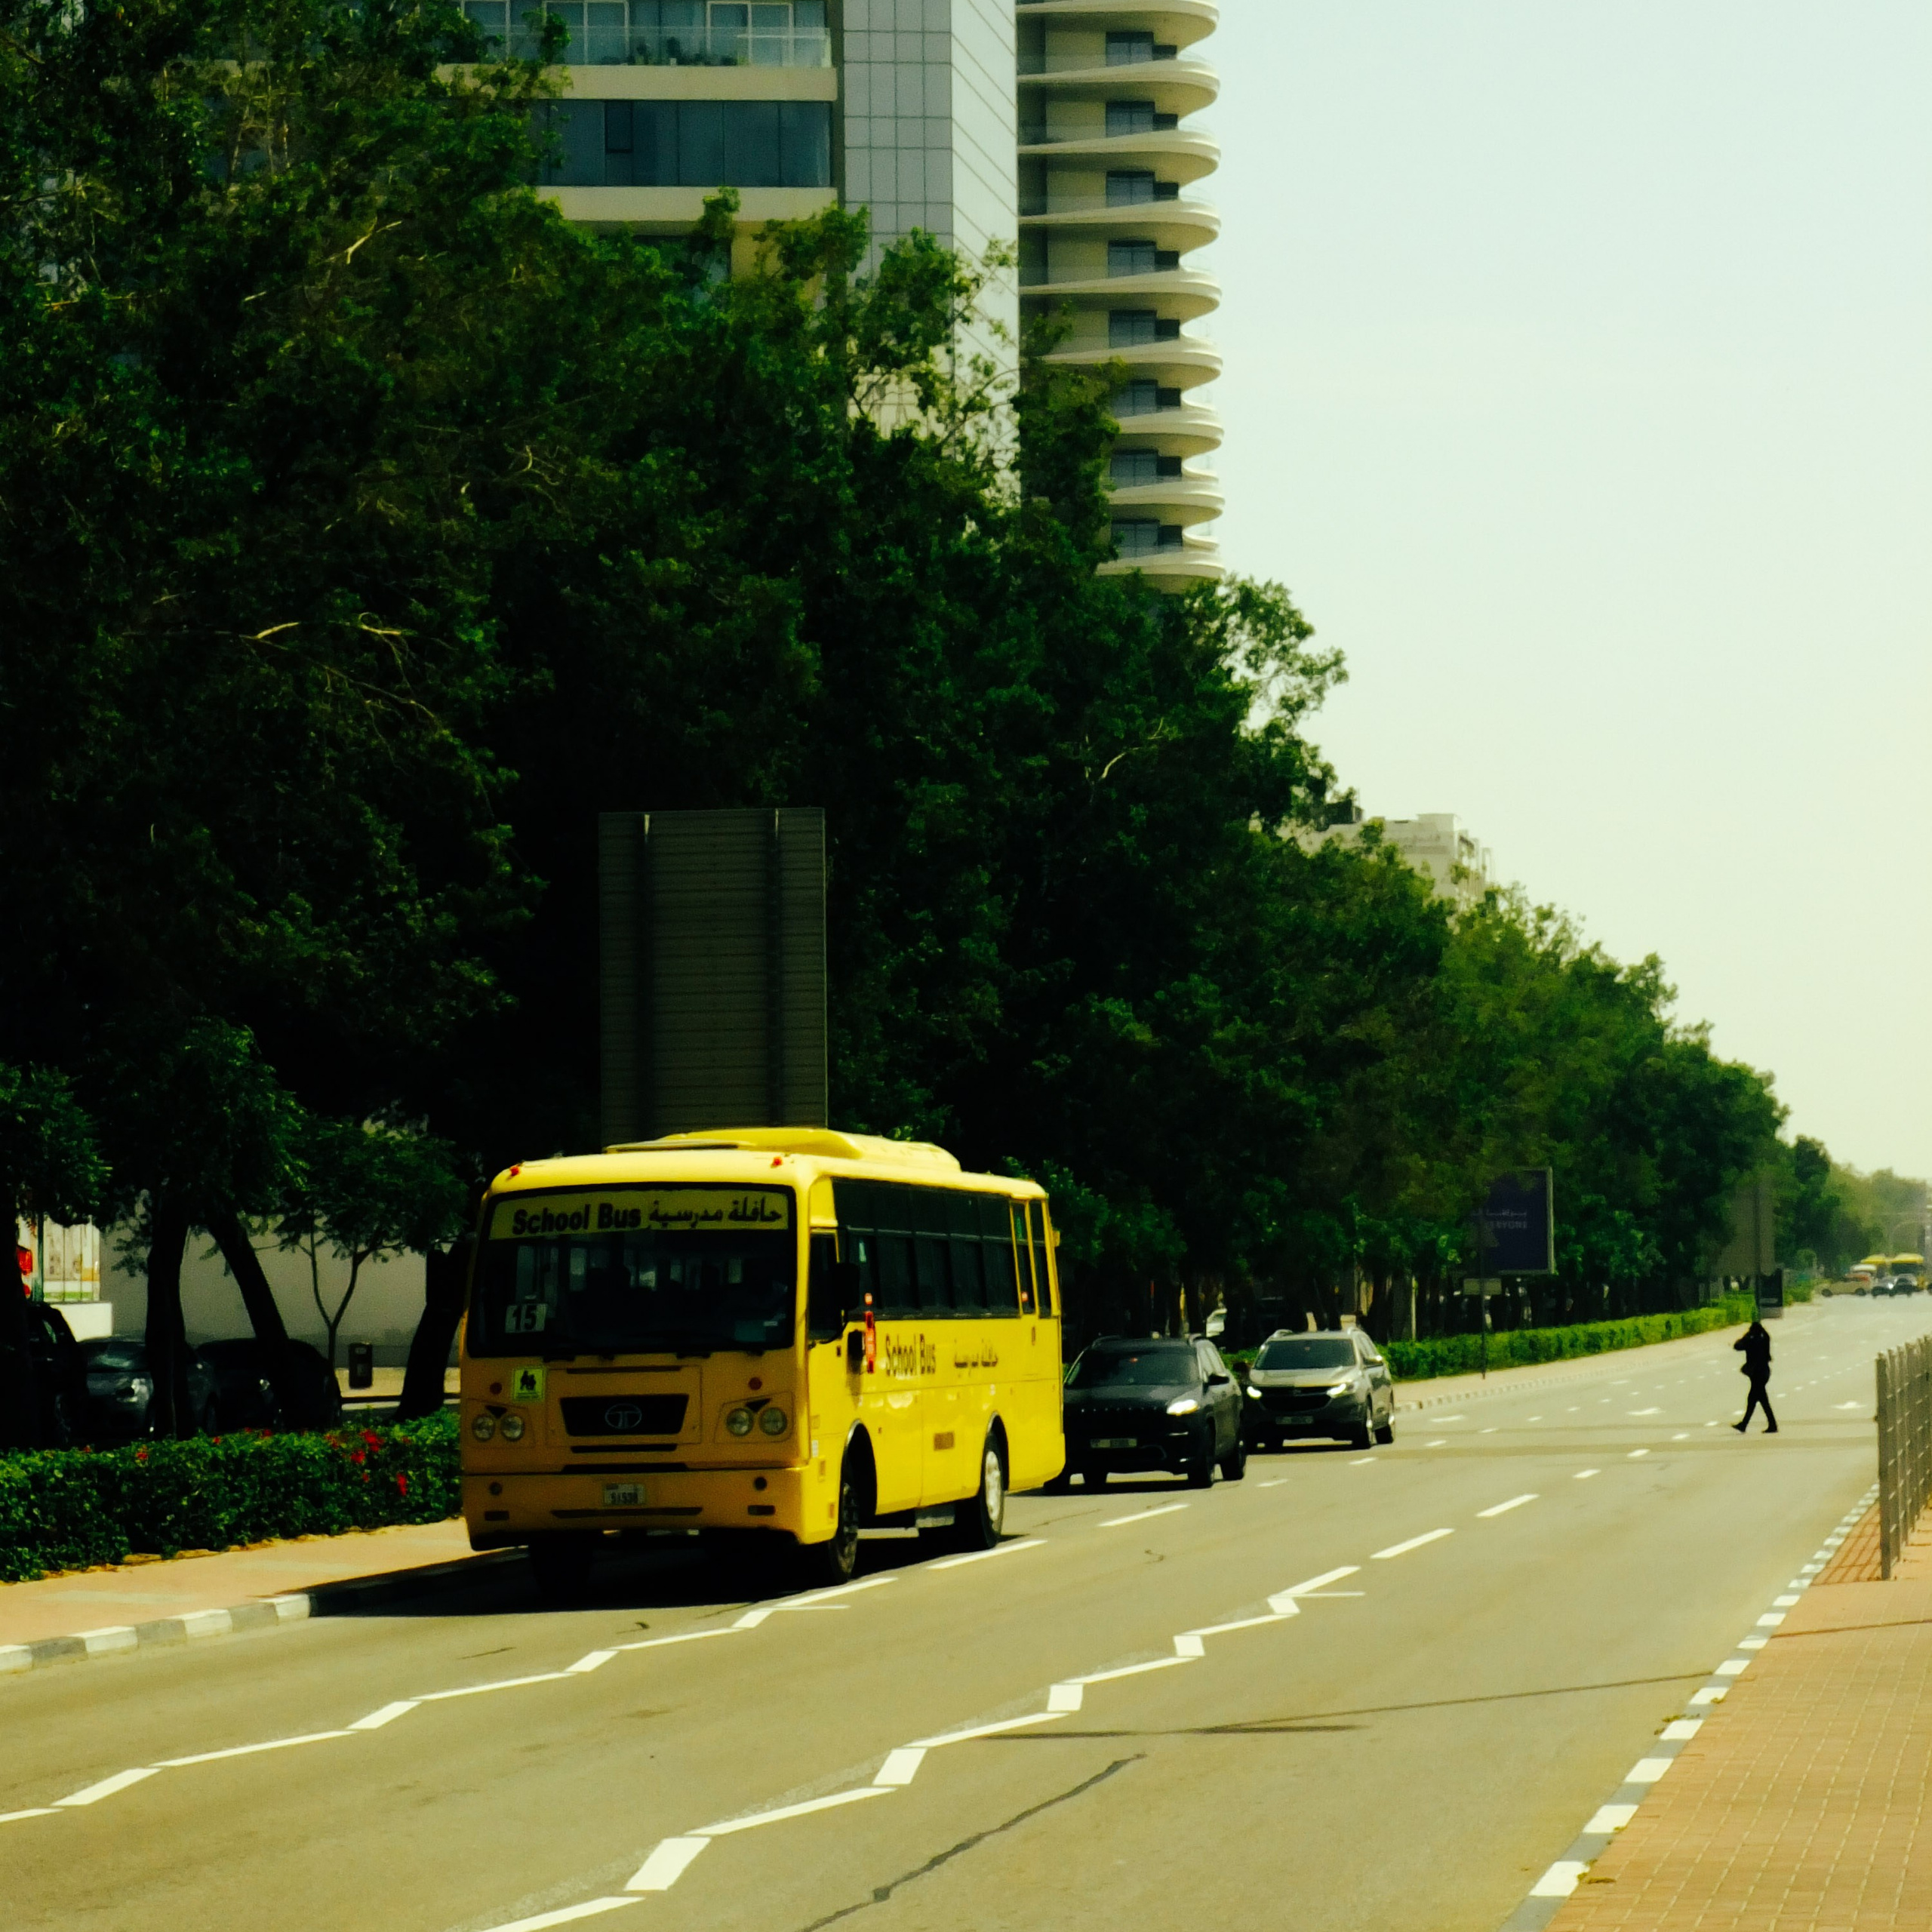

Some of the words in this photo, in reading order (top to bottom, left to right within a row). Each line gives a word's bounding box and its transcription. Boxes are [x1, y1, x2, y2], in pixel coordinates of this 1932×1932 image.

[512, 1204, 590, 1235] School
[597, 1202, 641, 1229] Bus
[649, 1199, 723, 1229] مدرسية
[728, 1196, 783, 1223] حافلة
[512, 1305, 537, 1331] 15
[885, 1333, 917, 1377] School
[919, 1333, 937, 1375] Bus
